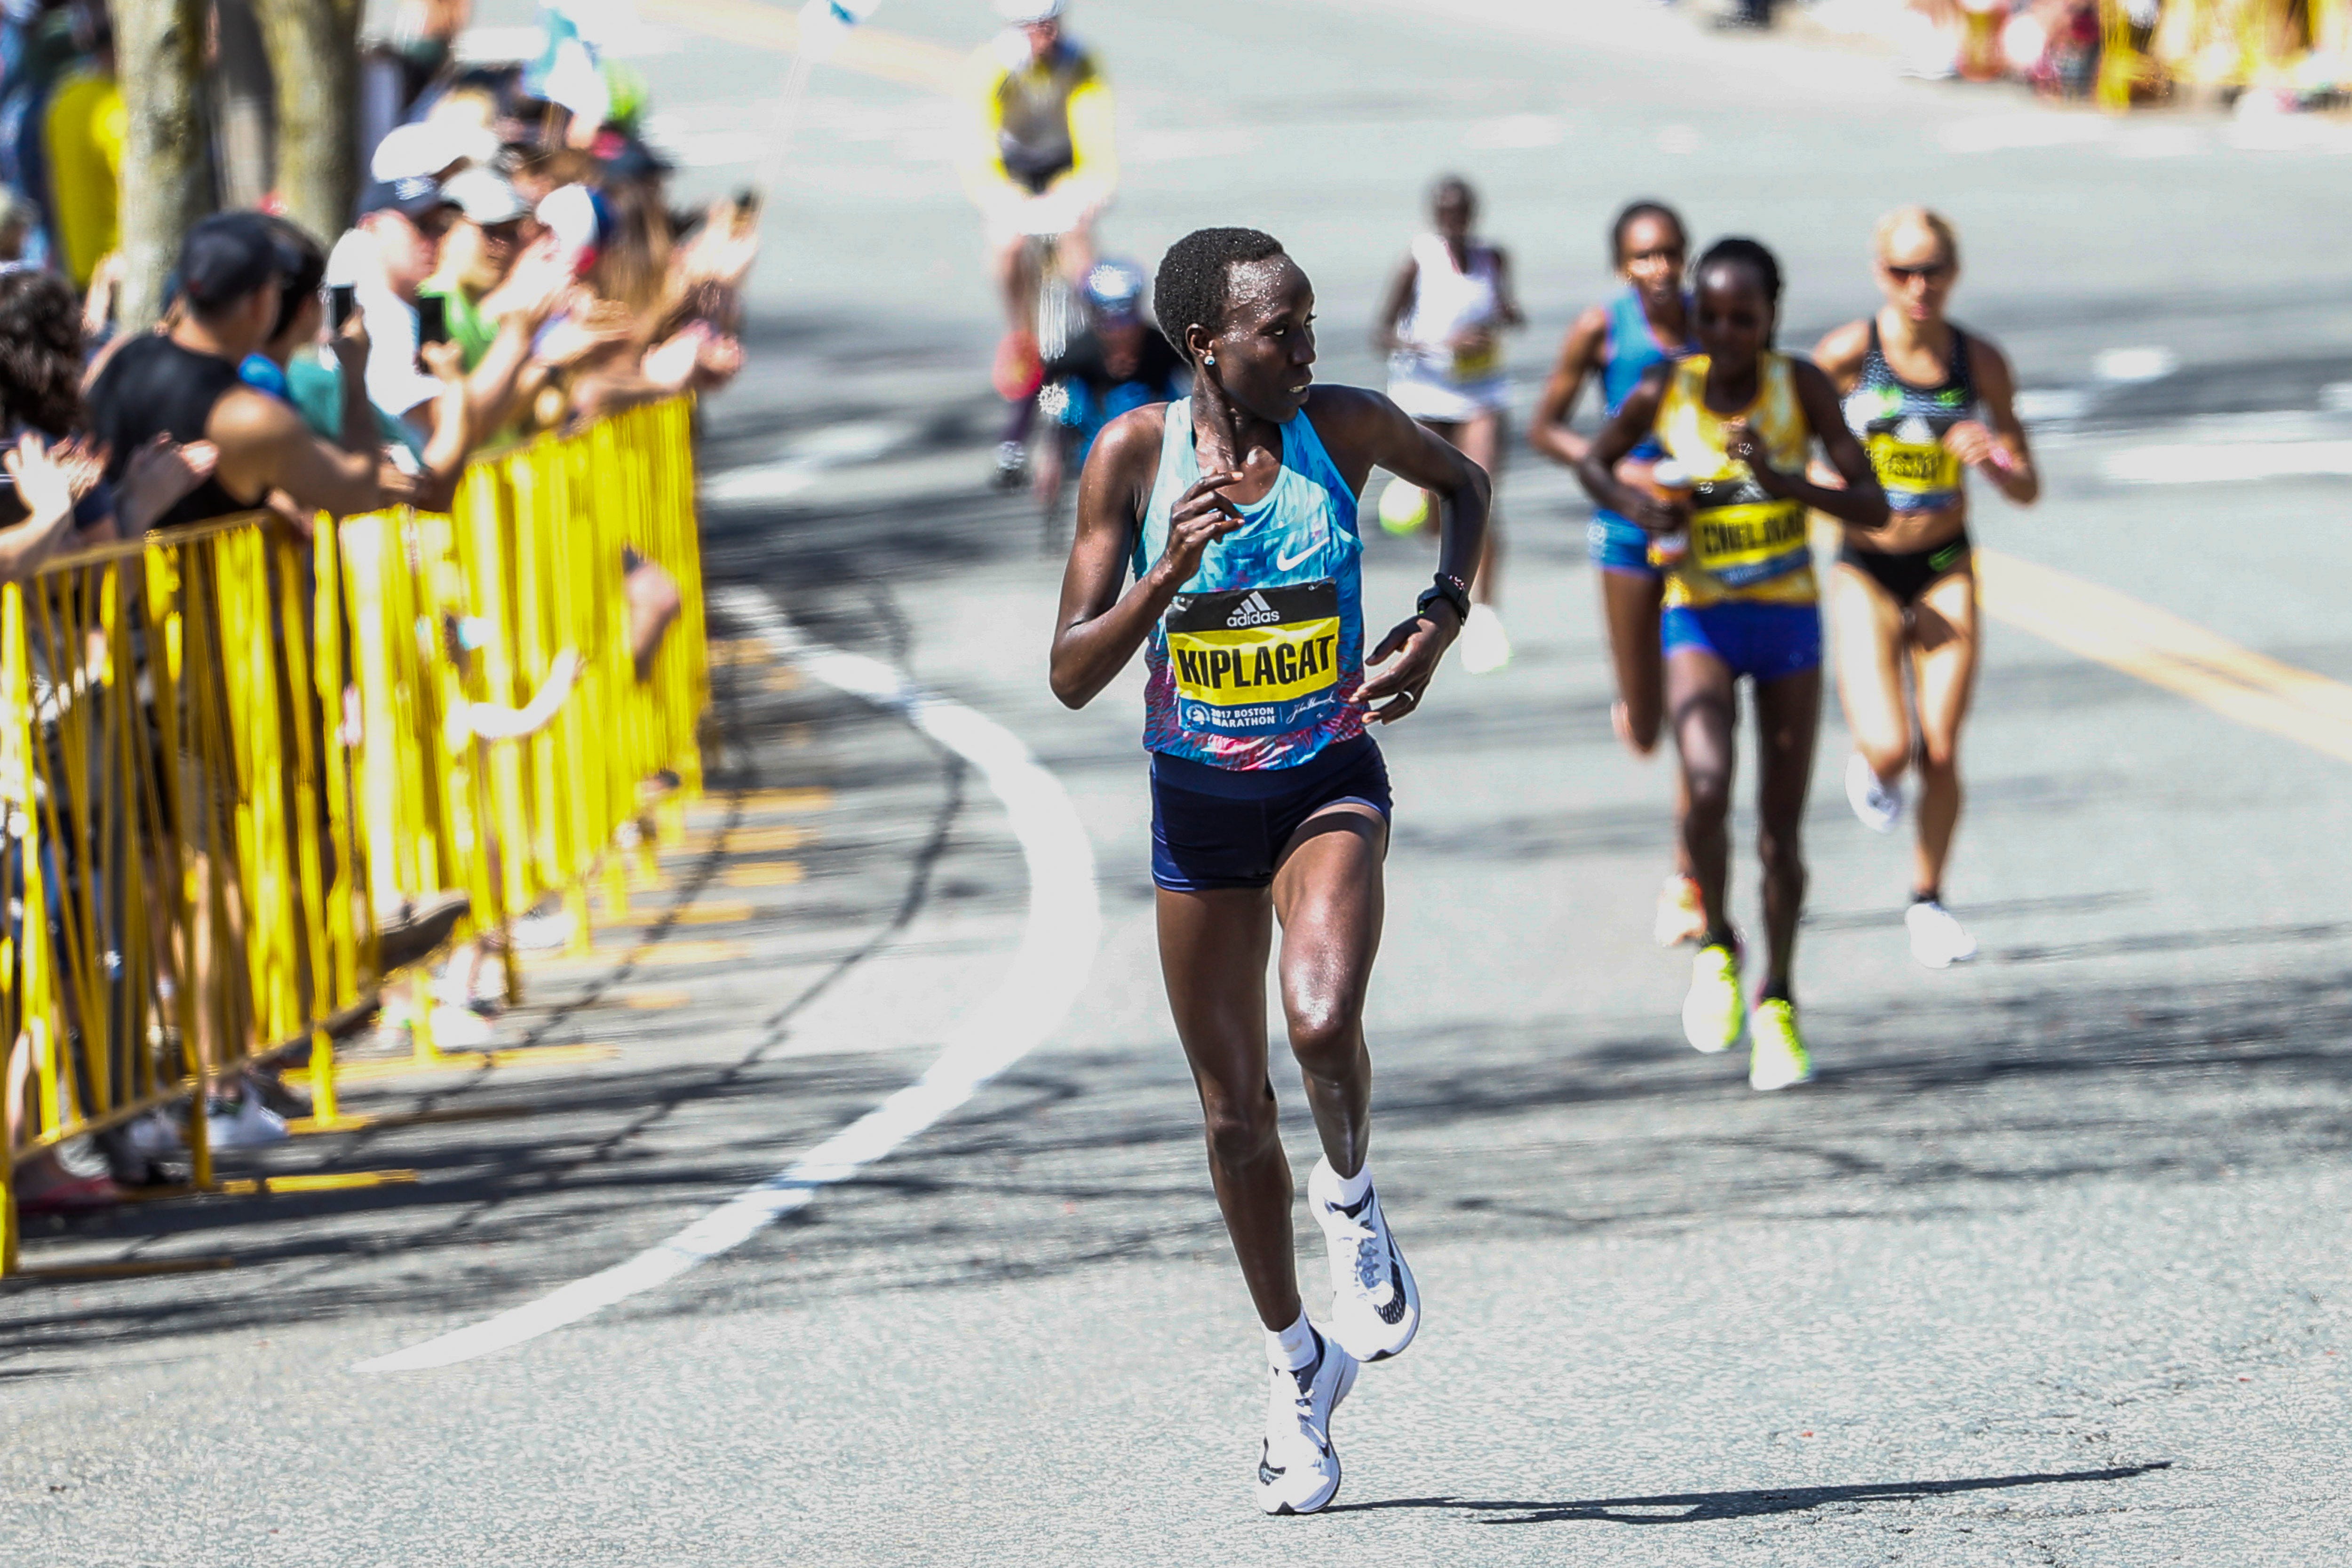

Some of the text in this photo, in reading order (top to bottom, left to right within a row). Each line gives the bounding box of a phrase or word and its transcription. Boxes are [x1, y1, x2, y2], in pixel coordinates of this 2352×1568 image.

[1226, 611, 1279, 627] adidas
[1176, 635, 1335, 689] KIPLAGAT
[1211, 707, 1274, 718] 2017 BOSTON
[1212, 717, 1275, 728] MARATHON
